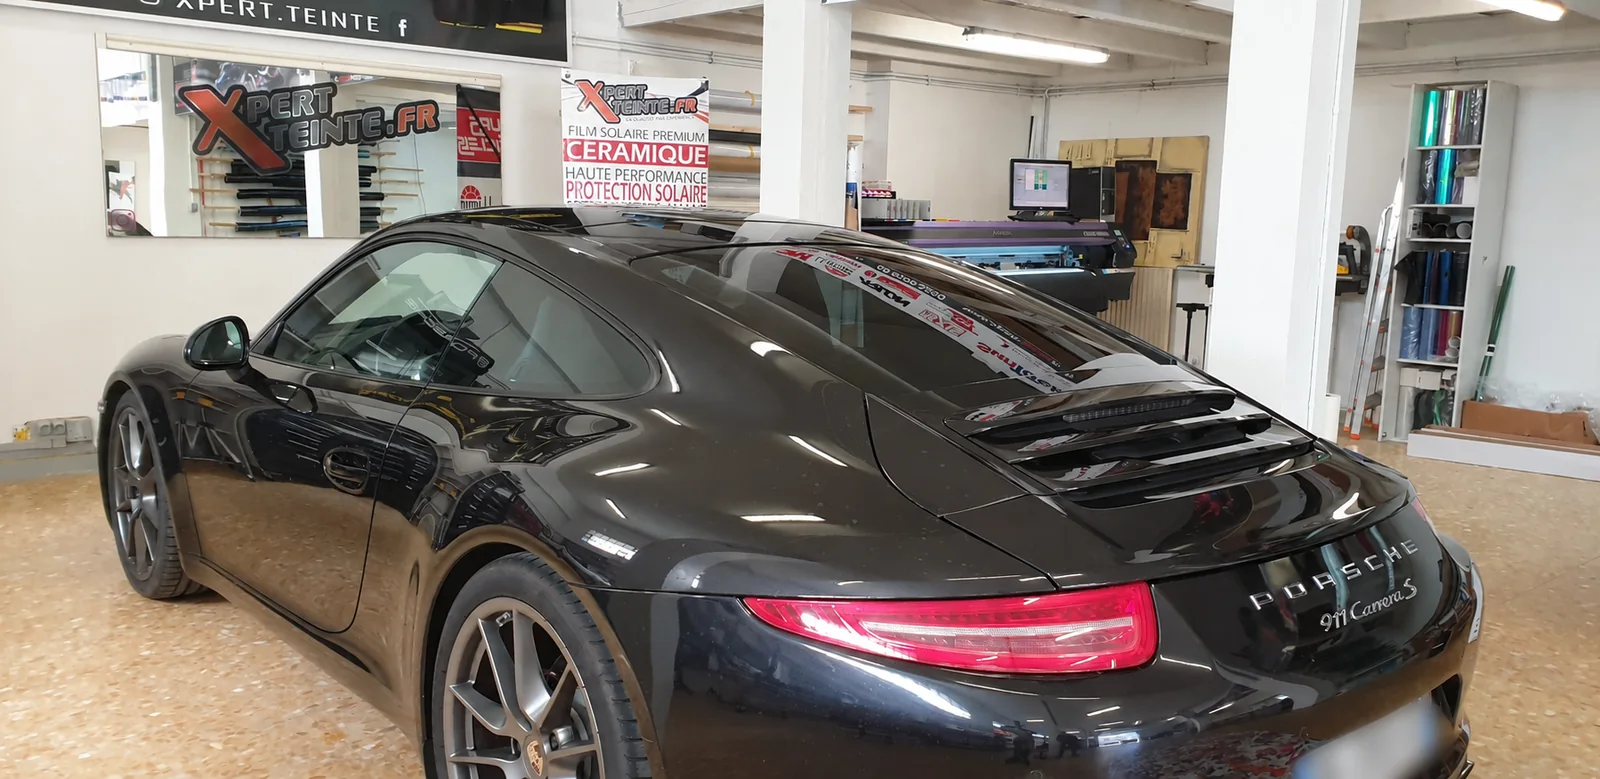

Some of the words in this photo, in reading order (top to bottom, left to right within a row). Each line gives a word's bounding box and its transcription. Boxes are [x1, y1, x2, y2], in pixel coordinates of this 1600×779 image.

[612, 98, 698, 116] TEINTE.FR
[268, 103, 438, 152] TEINTE.FR
[568, 125, 597, 137] FILM
[600, 127, 649, 140] SOLAIRE
[653, 130, 705, 143] PREMIUM
[566, 141, 707, 165] CERAMIQUE
[565, 167, 611, 180] HAUTE
[615, 168, 707, 184] PERFORMANCE
[566, 181, 652, 202] PROTECTION
[655, 184, 707, 203] SOLAIRE
[1249, 539, 1419, 611] PORSCHE
[1319, 608, 1349, 632] 911
[1350, 591, 1405, 621] Carrera
[1402, 578, 1418, 600] S
